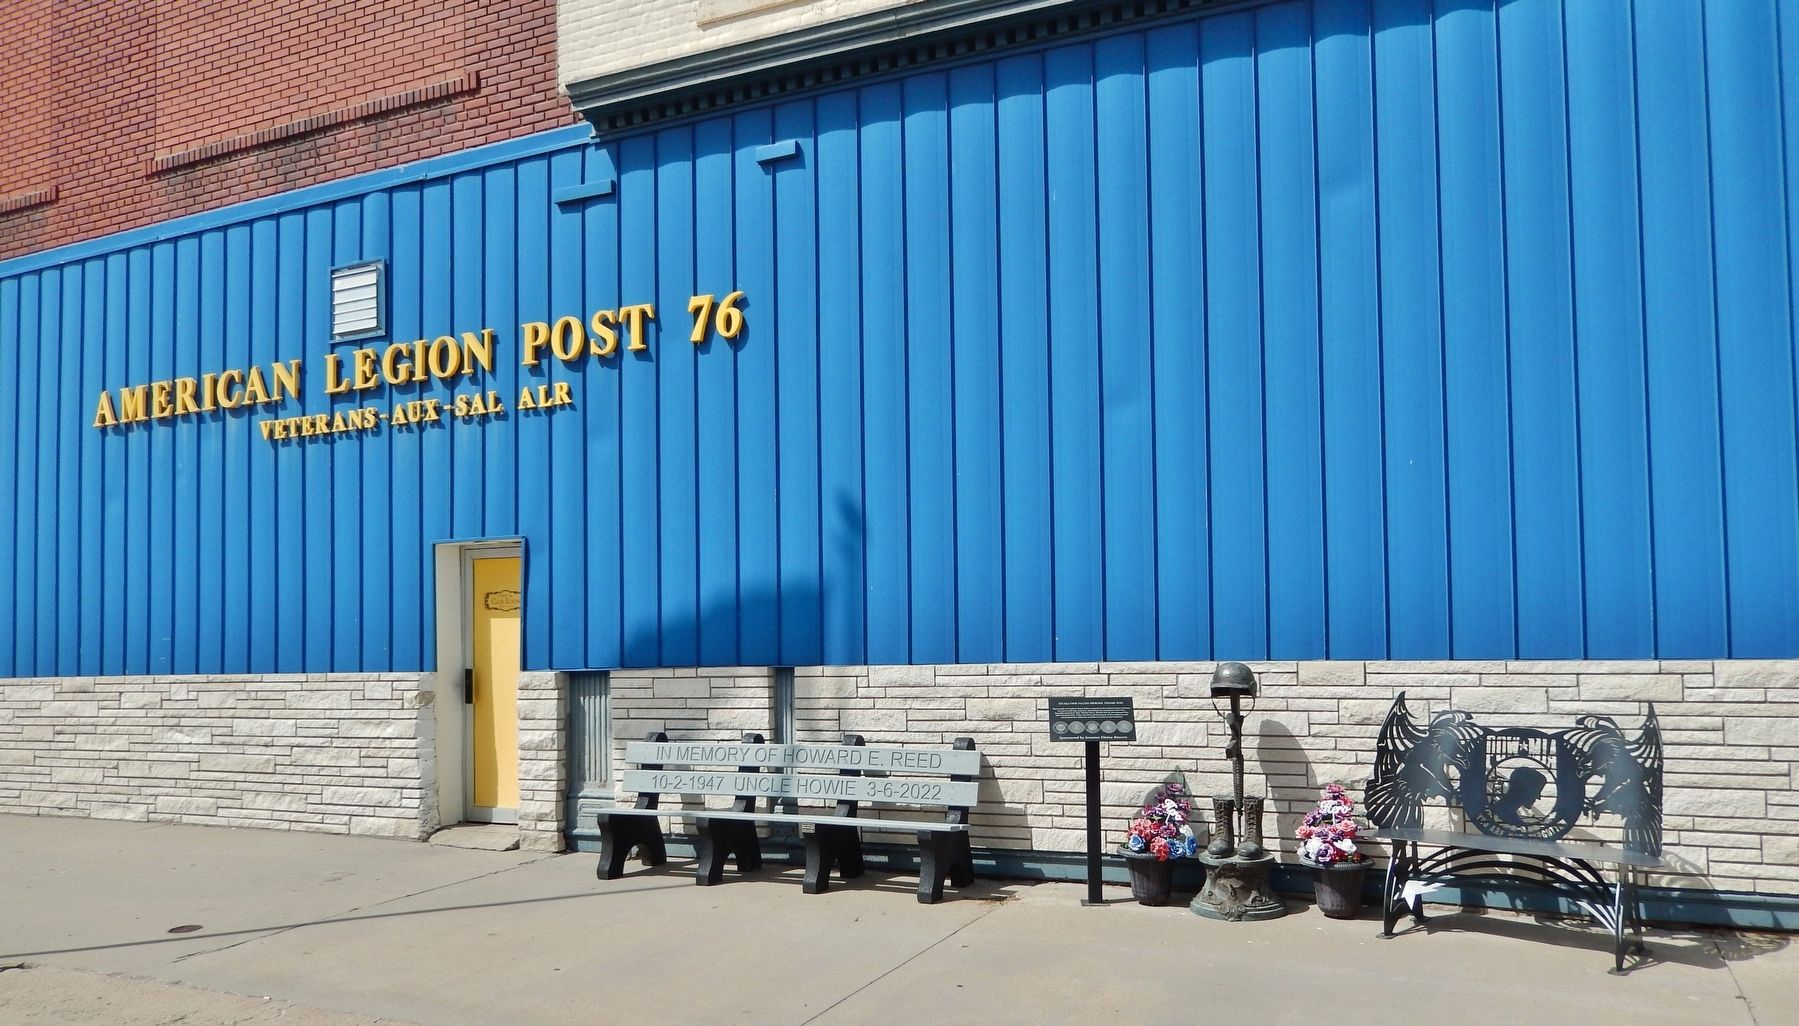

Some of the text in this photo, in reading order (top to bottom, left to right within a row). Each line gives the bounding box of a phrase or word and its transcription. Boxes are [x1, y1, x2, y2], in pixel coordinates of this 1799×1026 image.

[92, 290, 745, 428] AMERICAN LEGION POST 76
[517, 381, 573, 410] ALR
[655, 745, 942, 770] IN MEMORY OF HOWARD E. REED
[651, 774, 942, 801] 10-2-1947 UNCLE HOWIE 3-6-2022
